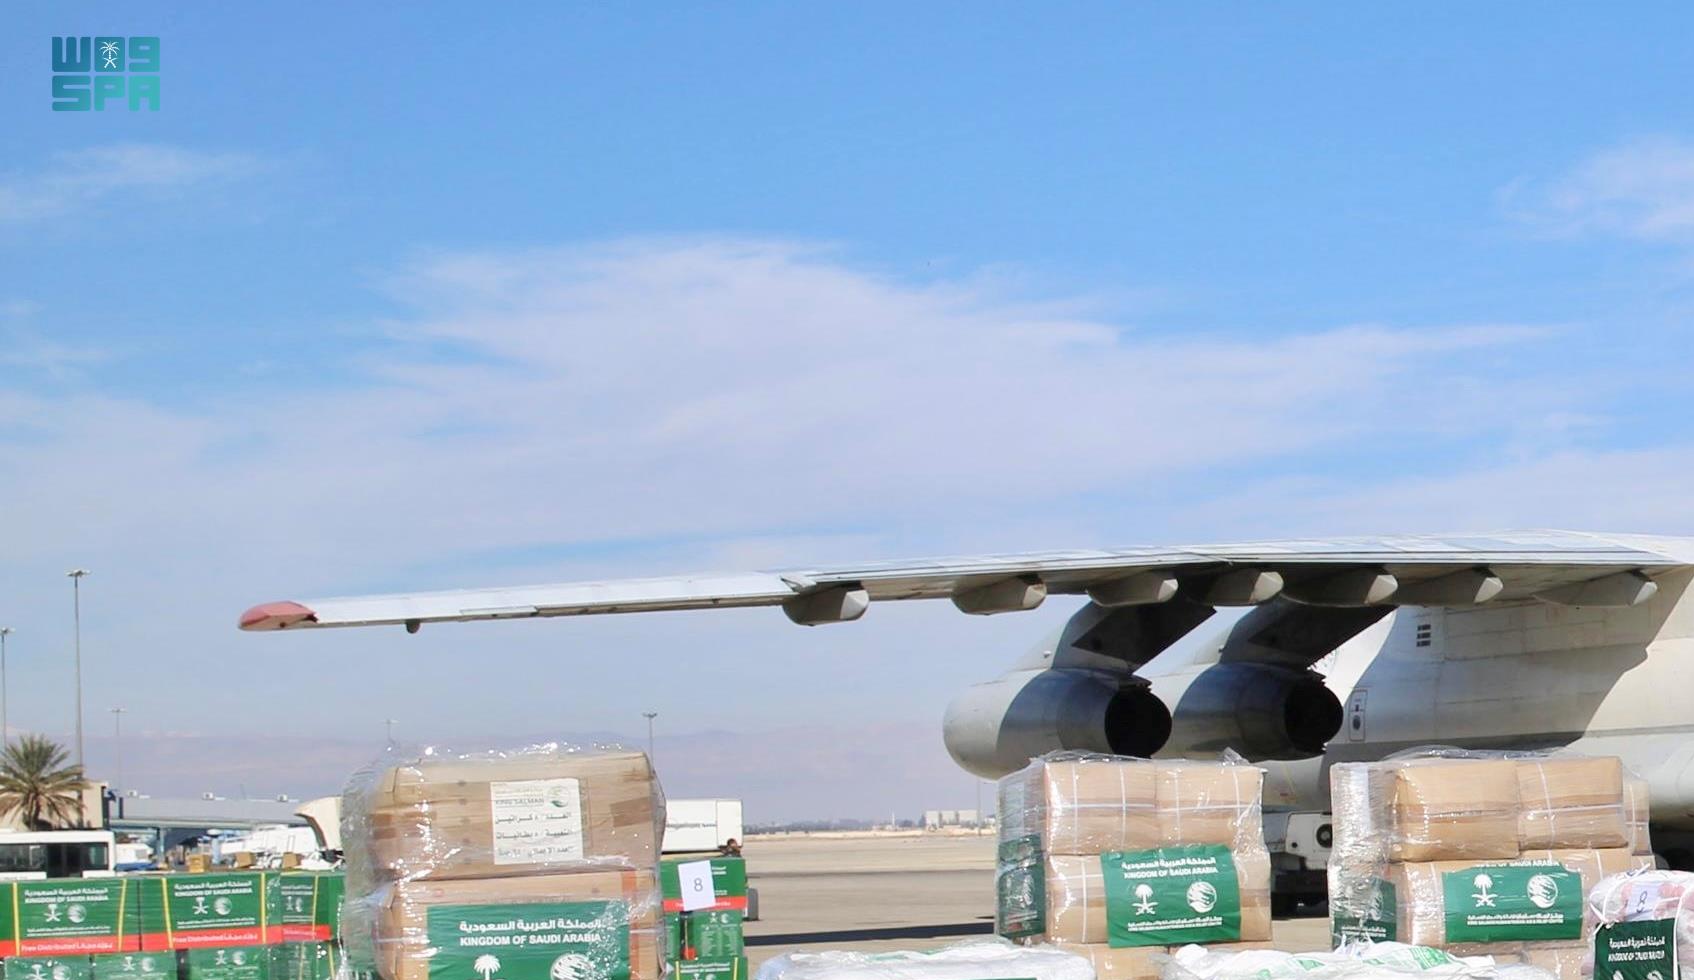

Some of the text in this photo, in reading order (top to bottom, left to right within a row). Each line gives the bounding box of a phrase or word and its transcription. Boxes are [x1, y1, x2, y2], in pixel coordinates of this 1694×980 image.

[694, 878, 703, 892] 8
[1636, 891, 1648, 913] 8
[460, 933, 601, 946] KINGDOM OF SAUDI ARABIA
